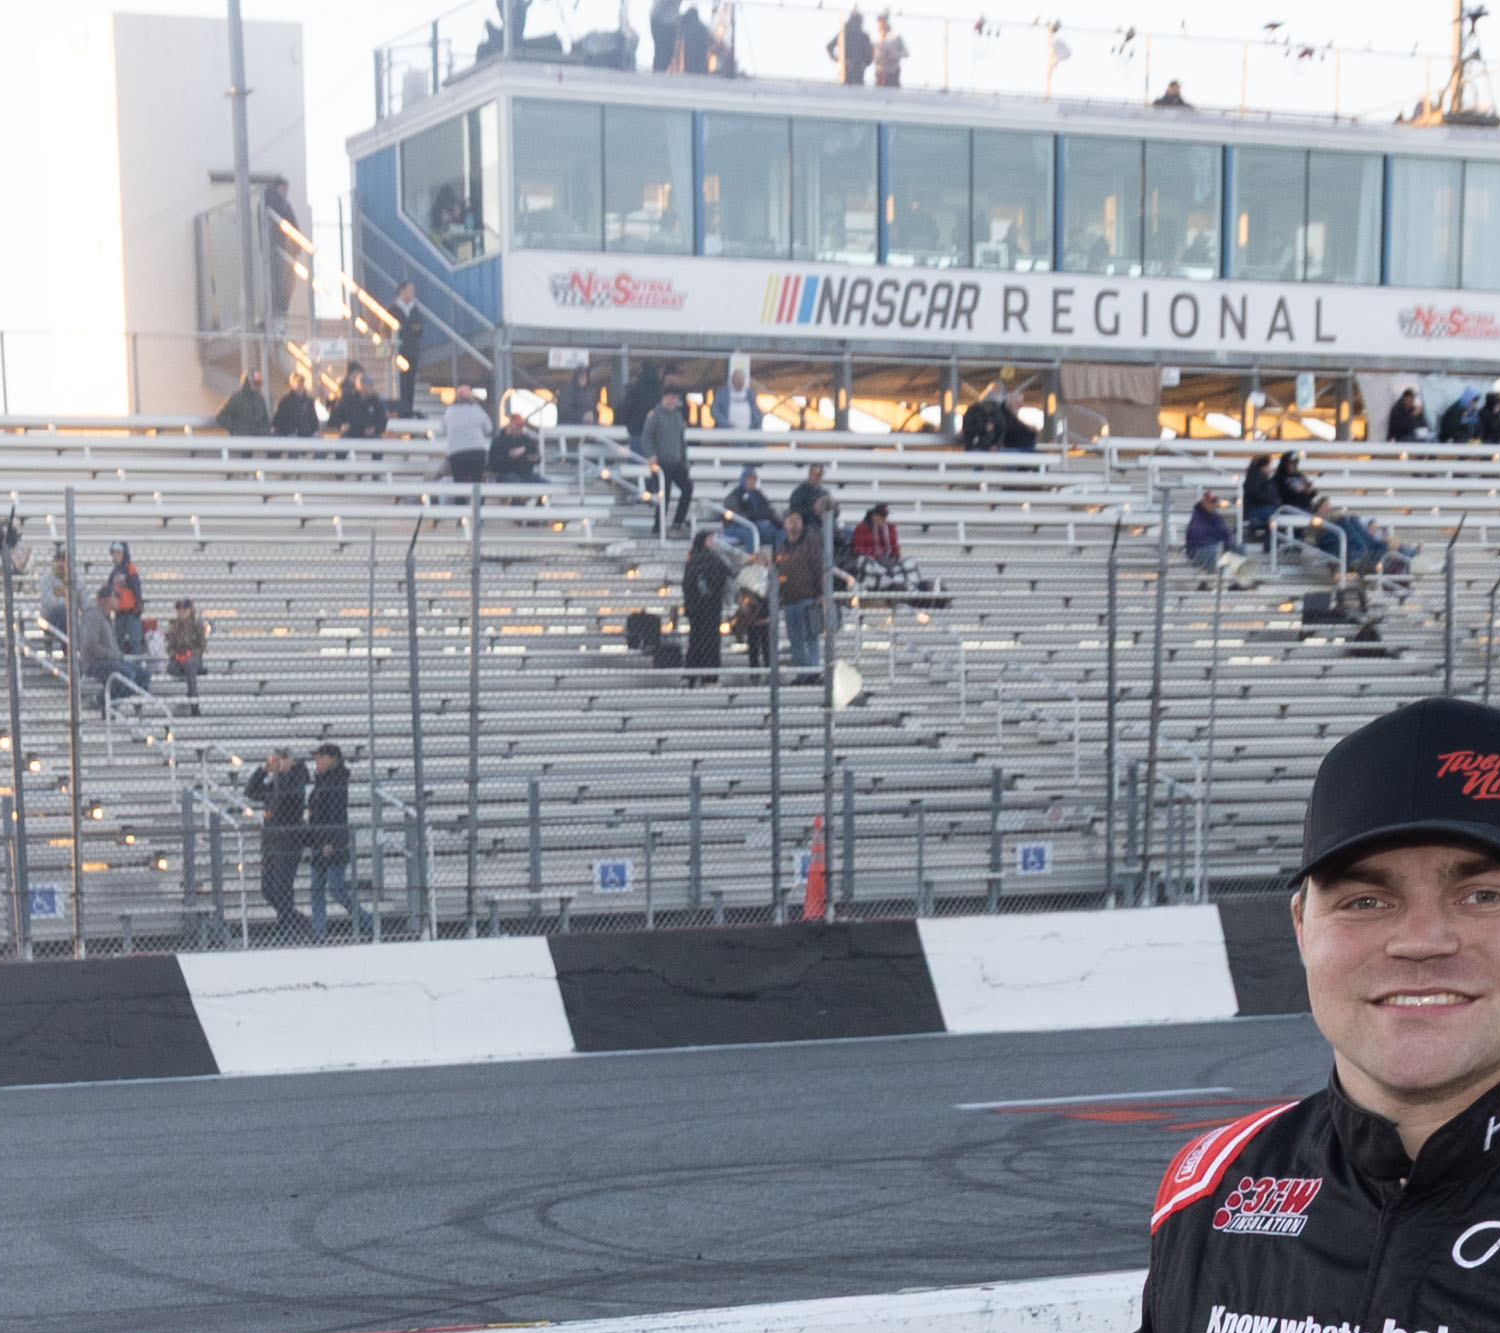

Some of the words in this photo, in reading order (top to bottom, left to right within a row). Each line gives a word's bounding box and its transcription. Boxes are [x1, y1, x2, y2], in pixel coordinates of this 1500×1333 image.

[815, 274, 981, 330] NASCAR
[1002, 284, 1337, 343] REGIONAL
[1232, 1215, 1304, 1234] INSULATION
